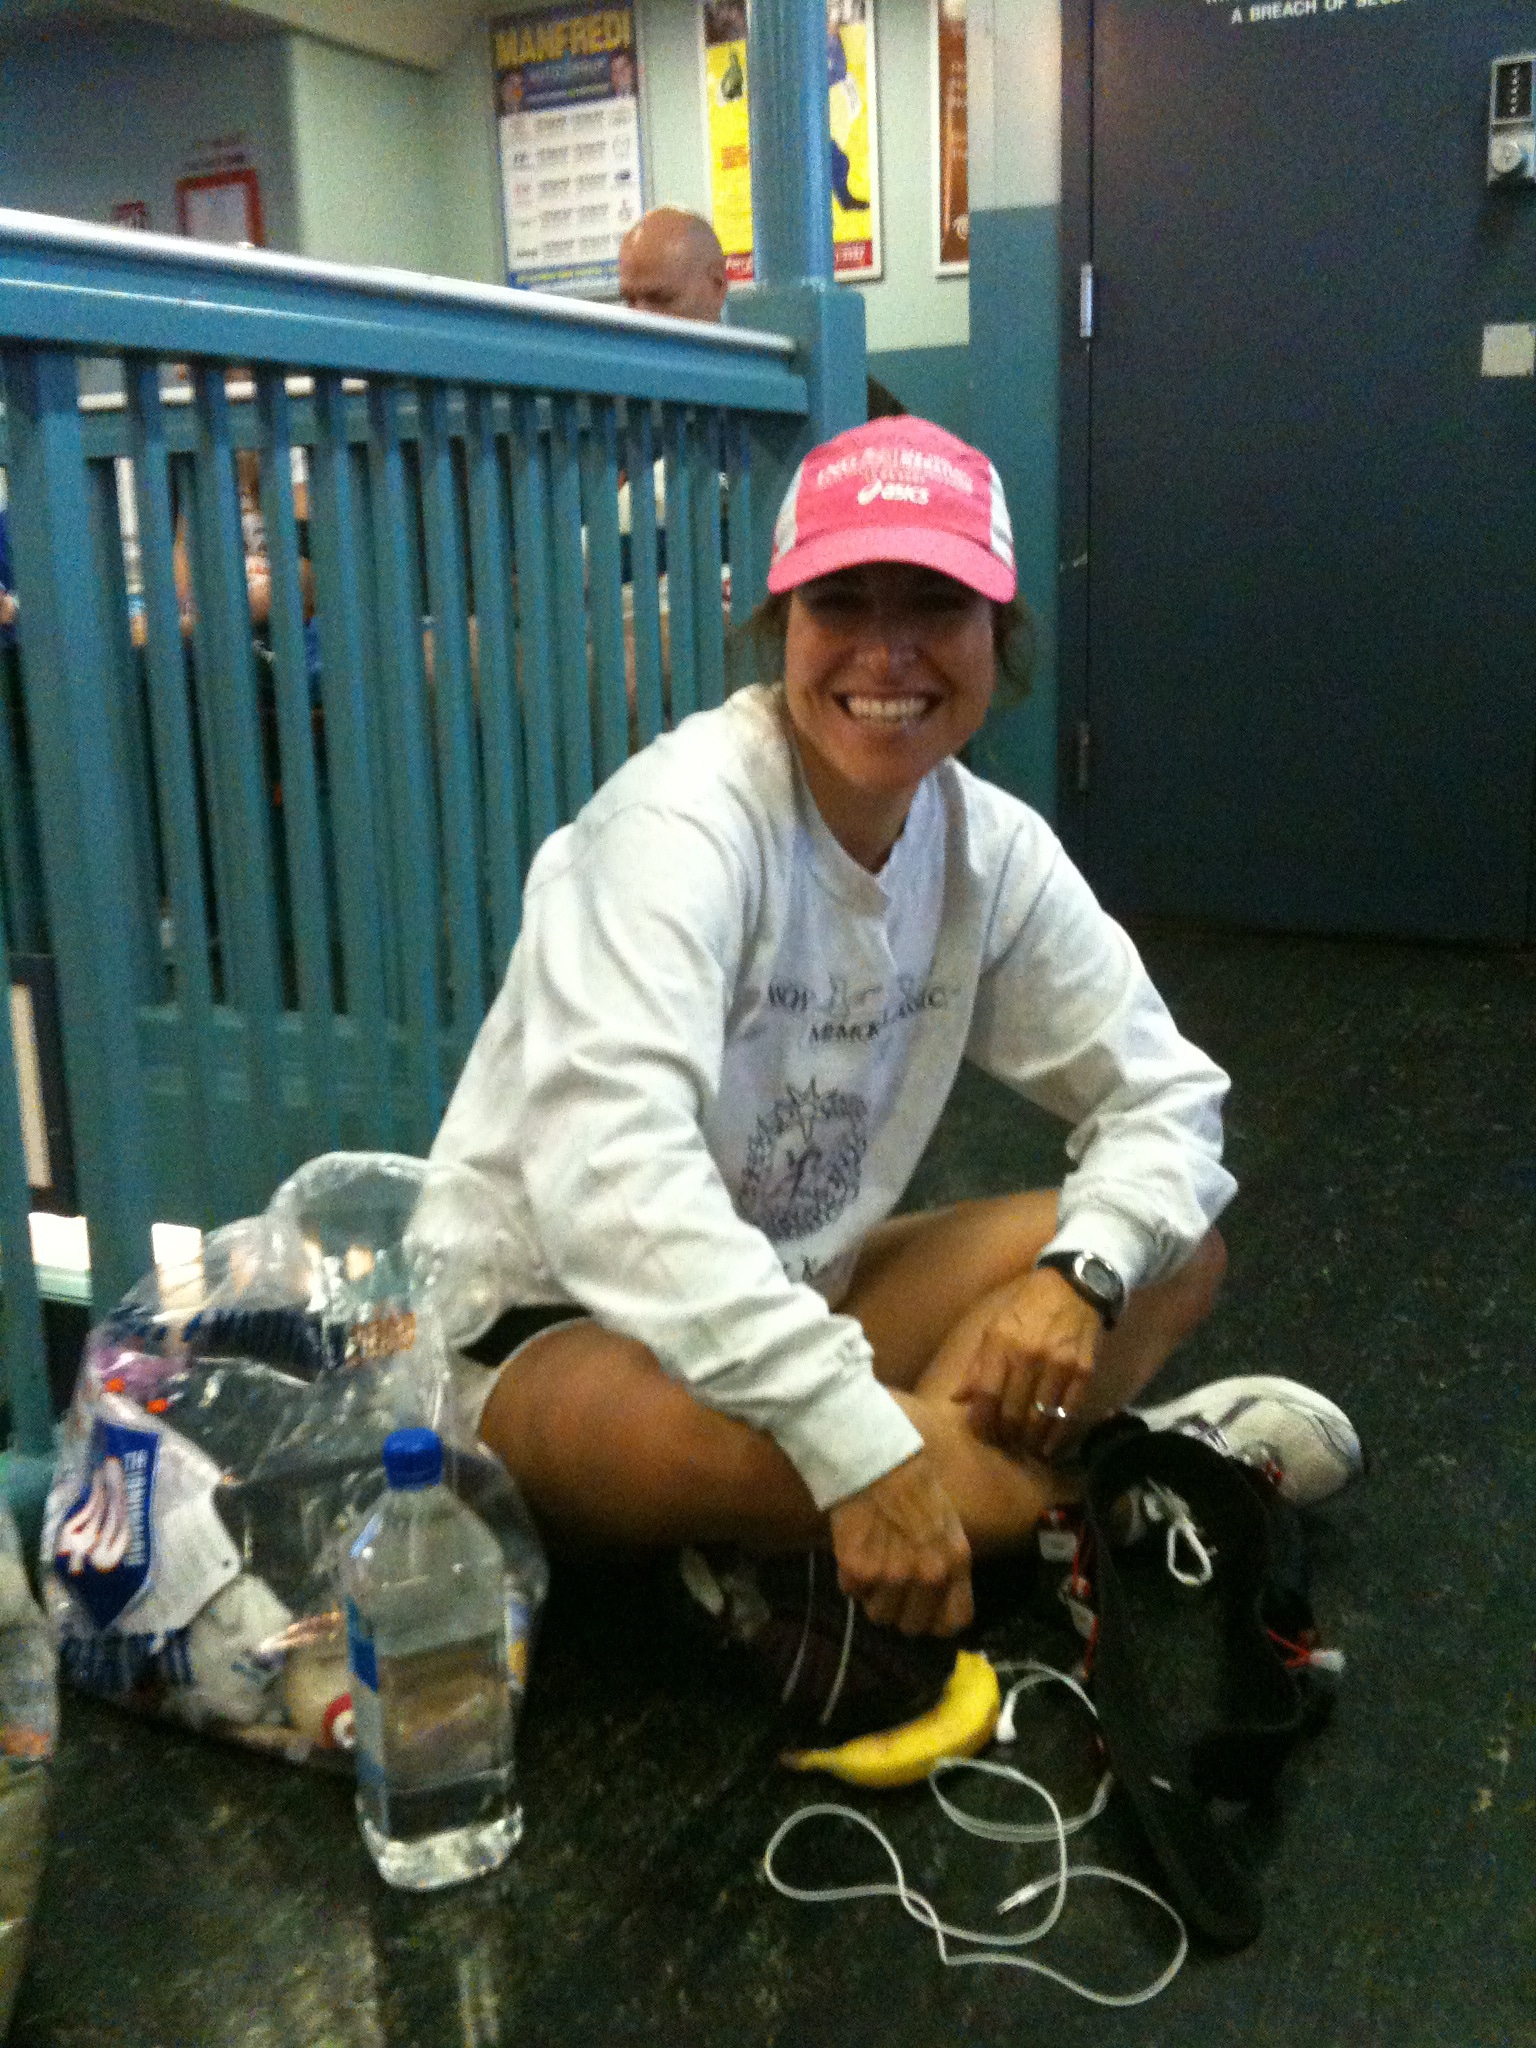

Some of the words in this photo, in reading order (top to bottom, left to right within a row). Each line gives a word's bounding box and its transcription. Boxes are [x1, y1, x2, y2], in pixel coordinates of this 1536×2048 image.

[1230, 6, 1243, 24] A
[1249, 0, 1317, 22] BREACH
[495, 8, 632, 68] MANFREDI
